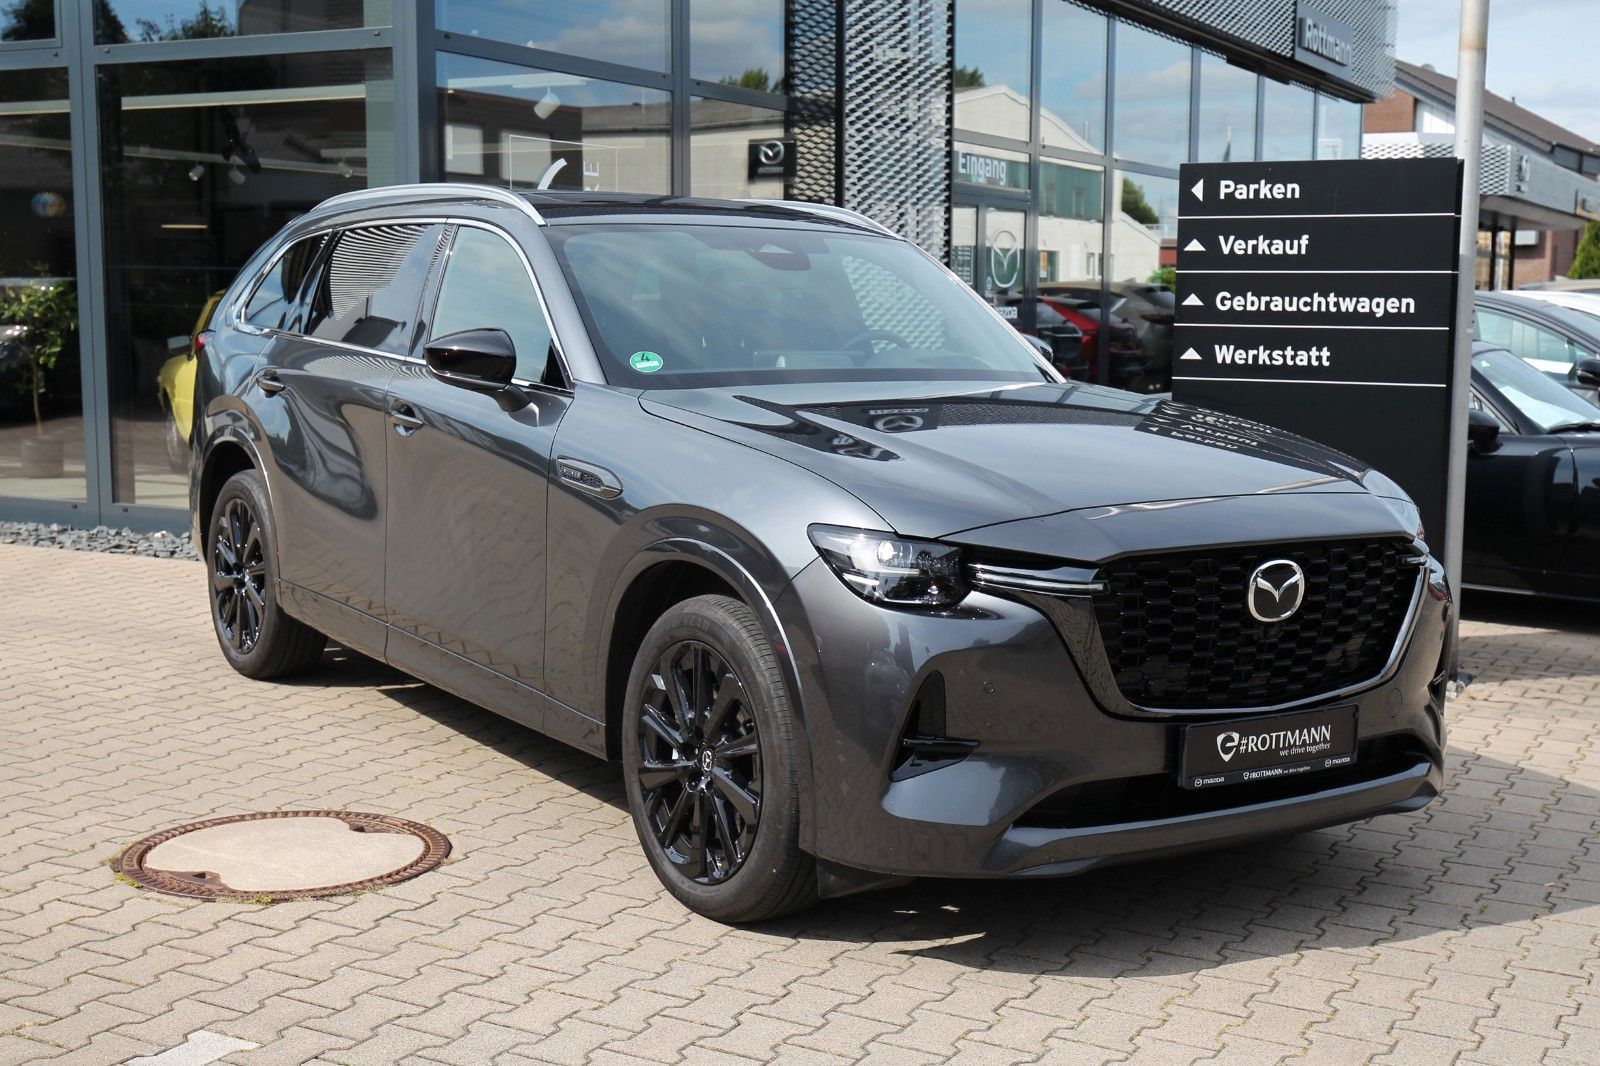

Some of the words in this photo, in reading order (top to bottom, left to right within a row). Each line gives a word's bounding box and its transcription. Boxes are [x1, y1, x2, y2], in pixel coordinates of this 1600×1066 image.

[1305, 17, 1351, 66] Rottmann
[958, 151, 1007, 185] Eingang
[1219, 178, 1301, 200] Parken
[1218, 234, 1310, 255] Verkauf
[1215, 291, 1416, 318] Gebrauchtwagen
[1214, 344, 1331, 367] Werkstatt
[1239, 724, 1331, 754] #ROTTMANN
[1290, 747, 1306, 756] drive
[1306, 742, 1331, 754] together
